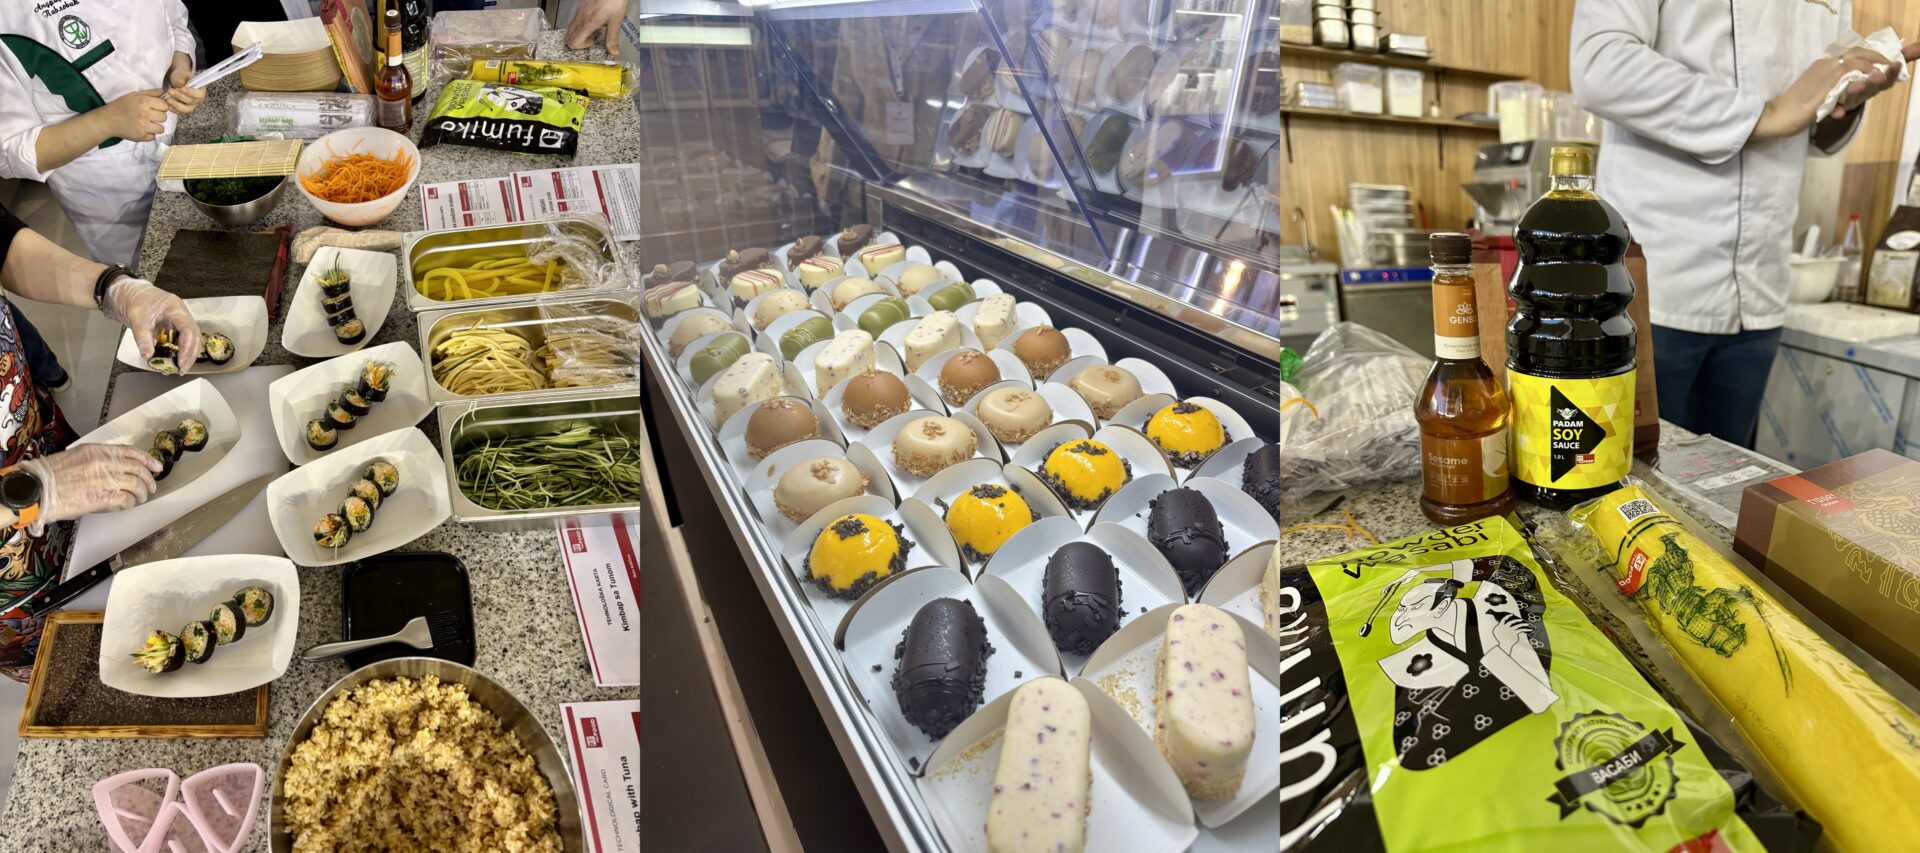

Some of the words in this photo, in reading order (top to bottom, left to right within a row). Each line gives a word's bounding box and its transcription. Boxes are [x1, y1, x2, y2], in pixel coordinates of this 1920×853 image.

[441, 120, 534, 147] fumiko
[1552, 428, 1584, 441] SOY
[606, 563, 617, 589] Tunom
[614, 590, 621, 600] sa
[617, 601, 630, 632] Kimbap
[600, 768, 610, 789] CARD
[620, 755, 632, 782] Tuna
[1590, 749, 1643, 785] ВАСАБИ
[625, 784, 638, 808] with
